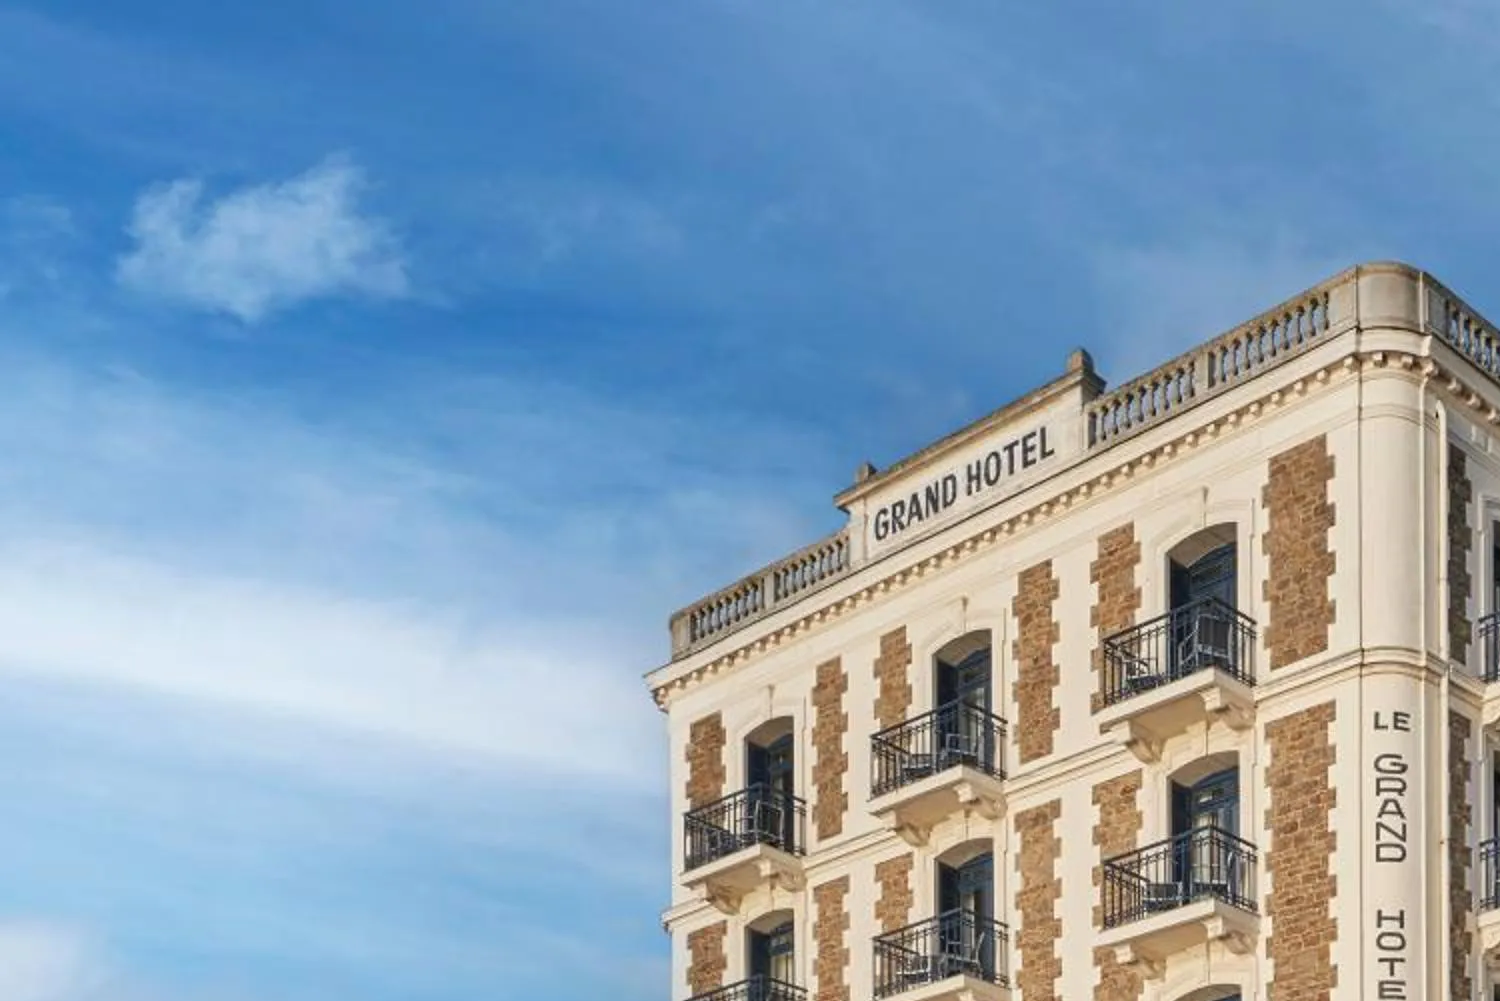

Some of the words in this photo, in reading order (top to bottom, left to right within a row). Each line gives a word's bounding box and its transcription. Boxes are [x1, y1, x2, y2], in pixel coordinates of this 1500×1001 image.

[874, 474, 957, 541] GRAND
[966, 426, 1055, 496] HOTEL
[1374, 711, 1411, 732] LE
[1374, 753, 1408, 863] GRAND
